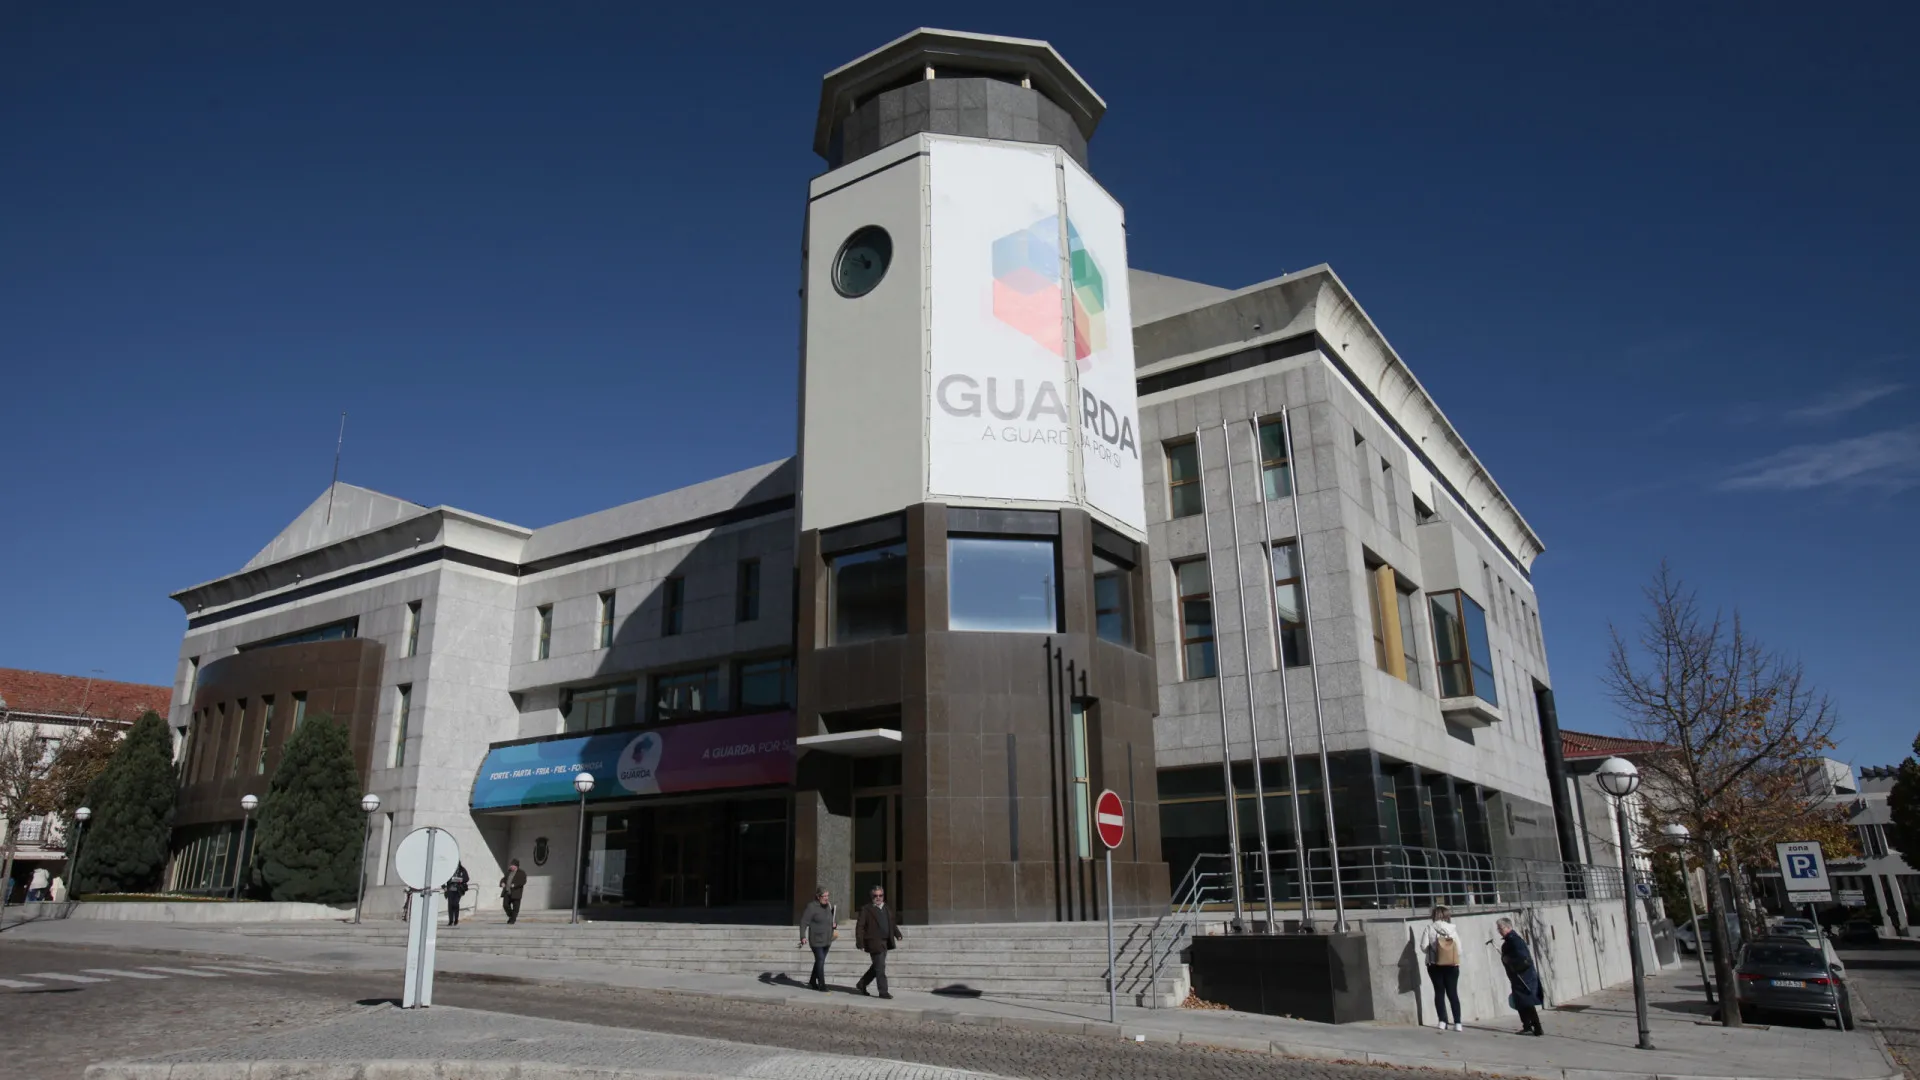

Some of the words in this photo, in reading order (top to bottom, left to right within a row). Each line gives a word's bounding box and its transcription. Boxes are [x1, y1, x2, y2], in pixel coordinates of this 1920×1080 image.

[981, 425, 996, 441] A
[702, 747, 711, 759] A
[712, 743, 756, 759] GUARDA
[758, 740, 781, 754] POR
[490, 771, 510, 781] FORTE
[512, 768, 532, 779] FARTA
[535, 767, 550, 776] FRIA
[553, 765, 567, 774] FIEL
[620, 769, 651, 780] GUARDA
[1792, 856, 1811, 876] P
